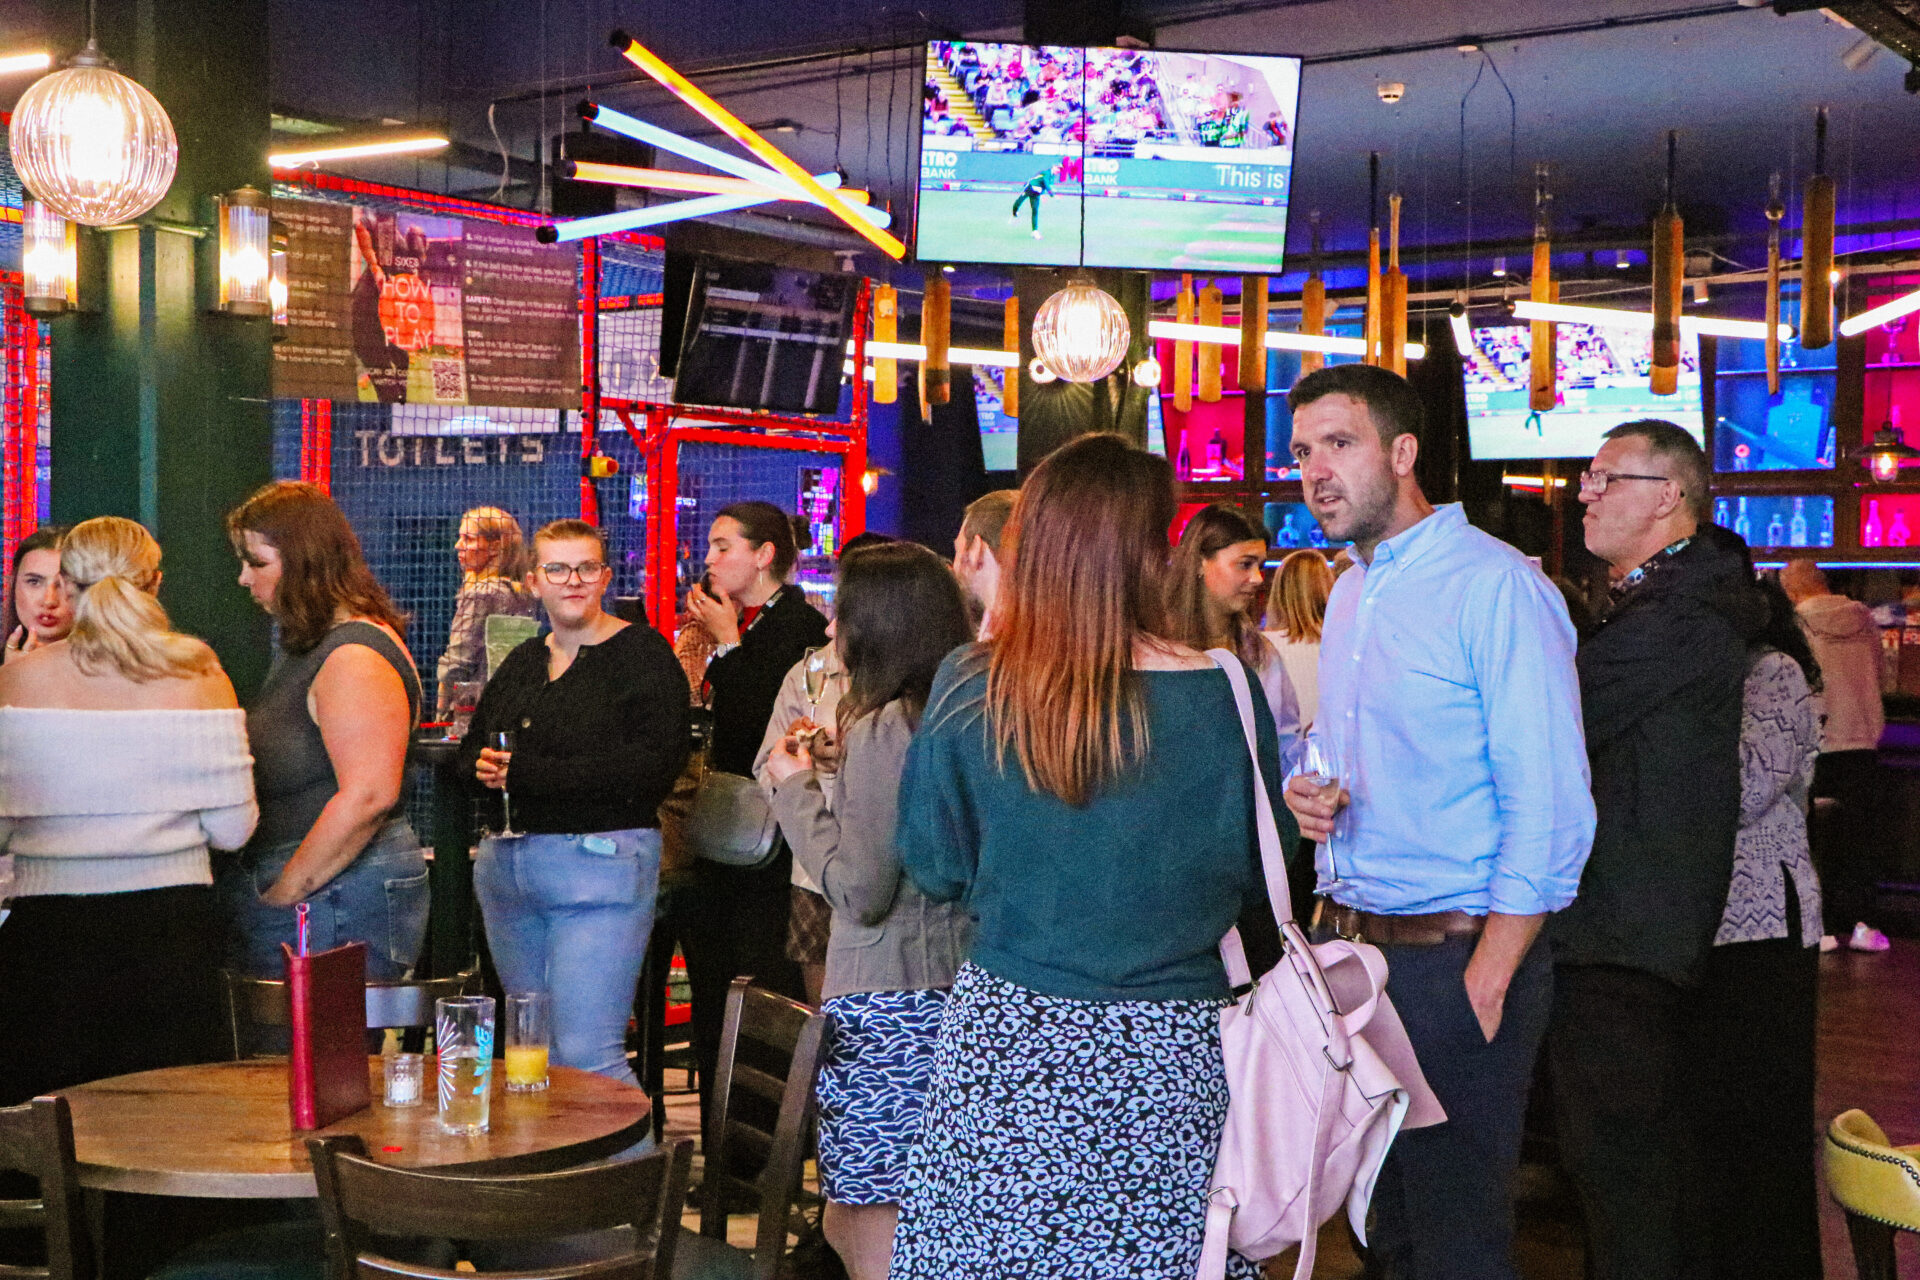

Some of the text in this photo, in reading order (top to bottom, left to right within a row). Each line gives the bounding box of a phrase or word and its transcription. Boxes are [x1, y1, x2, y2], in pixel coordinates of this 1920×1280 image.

[921, 167, 957, 179] BANK
[1083, 174, 1118, 186] BANK
[1214, 164, 1286, 189] This is
[382, 274, 431, 299] HOW
[394, 301, 421, 324] TO
[384, 326, 433, 351] PLAY
[355, 430, 544, 467] TOILETS
